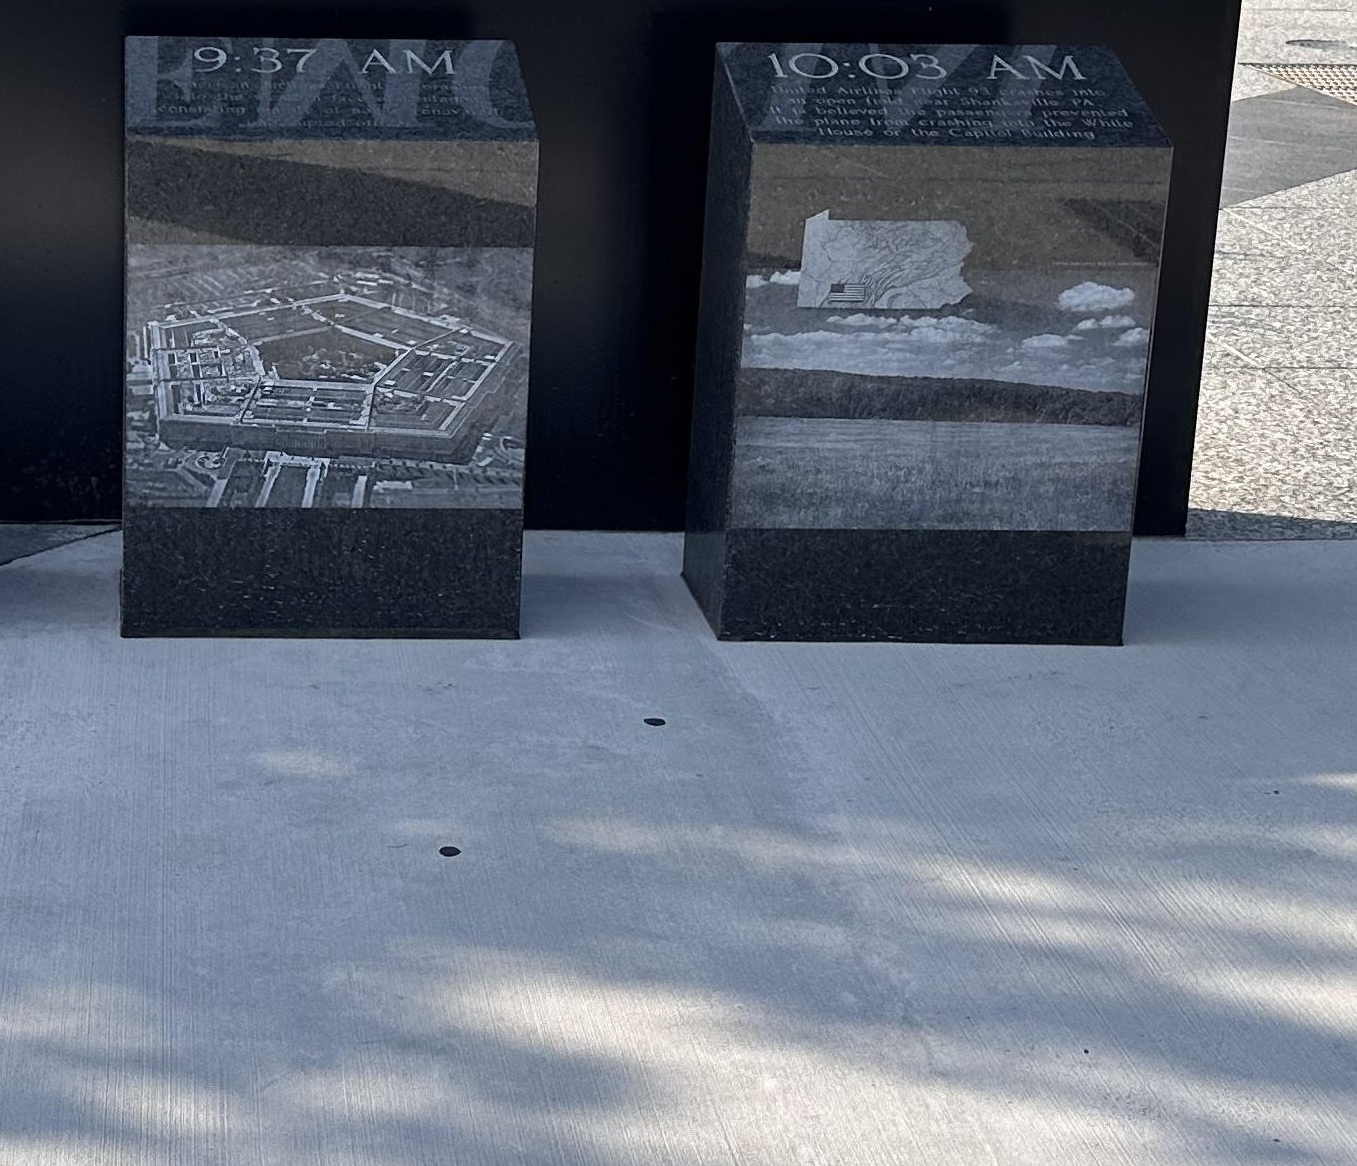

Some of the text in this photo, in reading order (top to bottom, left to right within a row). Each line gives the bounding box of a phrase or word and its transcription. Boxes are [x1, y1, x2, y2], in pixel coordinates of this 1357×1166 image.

[193, 46, 457, 75] 9:37 AM
[767, 52, 1087, 81] 10:03 AM
[770, 85, 827, 95] United
[837, 85, 903, 96] Airlines
[911, 86, 960, 97] Flight
[998, 87, 1065, 97] crashes
[1072, 87, 1106, 97] into
[814, 97, 857, 108] open
[157, 105, 246, 116] consiing
[815, 105, 889, 116] believed
[898, 107, 926, 116] the
[935, 108, 1032, 118] passenrs
[1042, 107, 1129, 118] prevented
[775, 114, 804, 126] the
[814, 115, 861, 127] plane
[868, 116, 909, 126] from
[917, 116, 993, 128] crashing
[1043, 118, 1072, 128] the
[1082, 118, 1133, 128] White
[817, 126, 1095, 140] House or the Capitol Building
